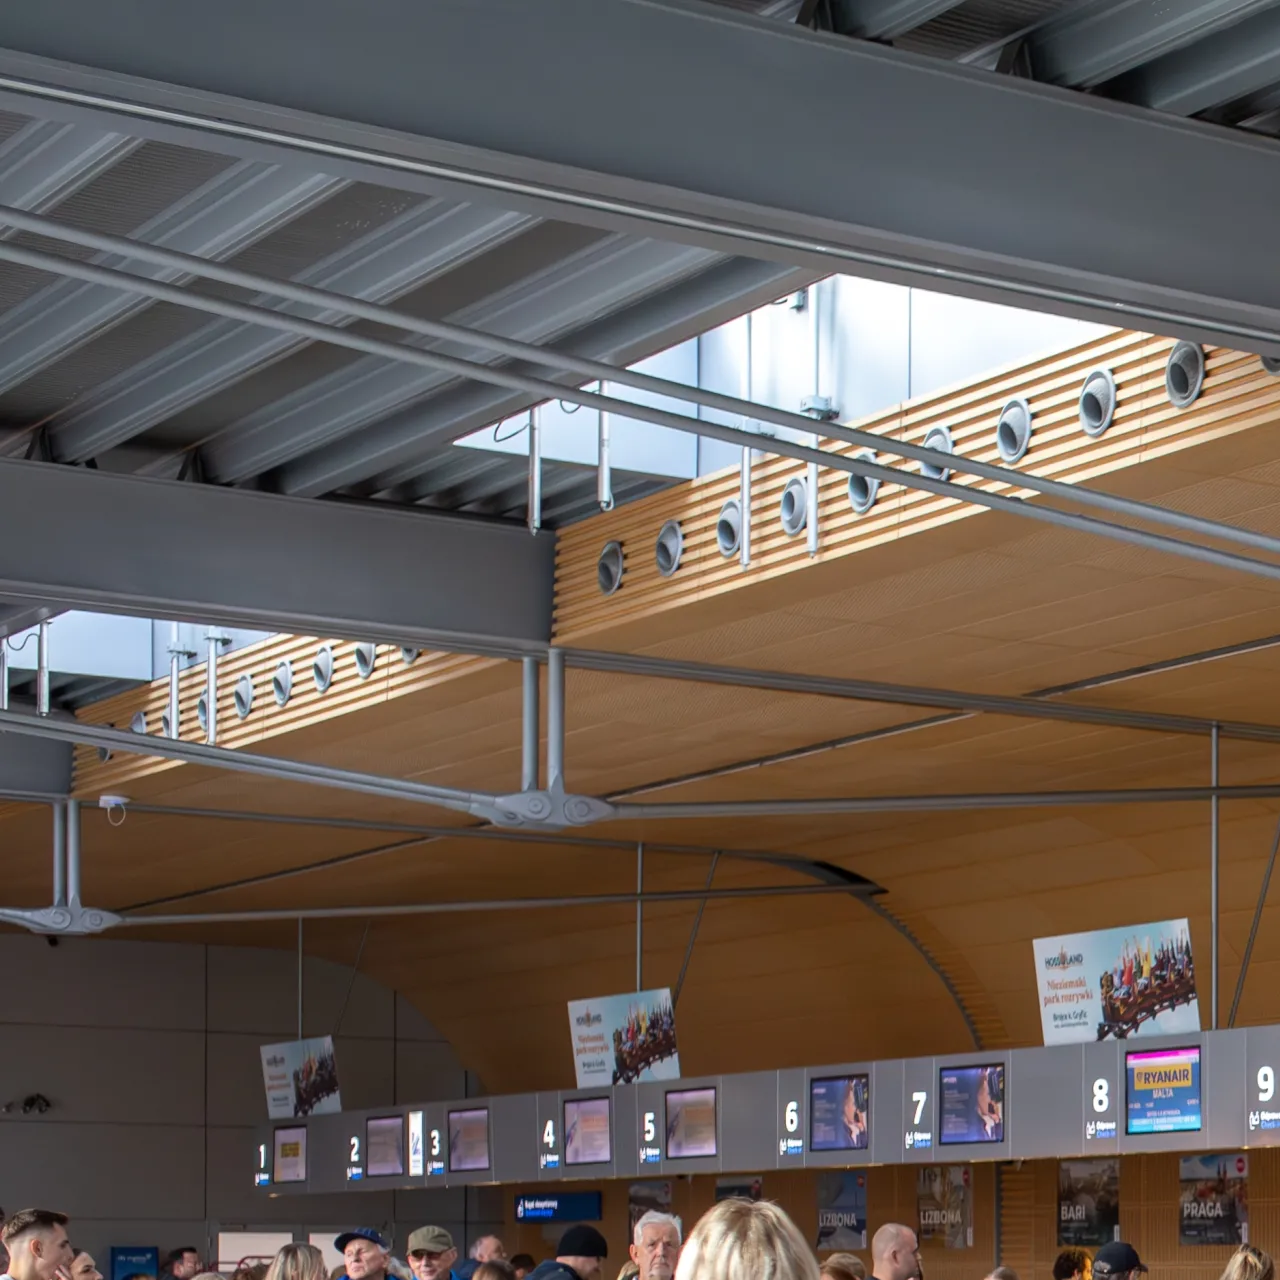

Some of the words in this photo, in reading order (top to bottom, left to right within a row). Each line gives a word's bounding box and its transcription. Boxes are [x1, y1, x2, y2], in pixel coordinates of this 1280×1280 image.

[1144, 1069, 1189, 1084] RYANAIR
[1257, 1066, 1274, 1101] 9
[1093, 1079, 1109, 1112] 8
[1153, 1089, 1173, 1098] MALTA
[785, 1101, 797, 1132] 6
[912, 1092, 926, 1124] 7
[543, 1120, 554, 1148] 4
[644, 1113, 655, 1141] 5
[350, 1137, 359, 1161] 2
[431, 1131, 440, 1155] 3
[259, 1145, 266, 1169] 1
[818, 1212, 856, 1228] LIZBONA
[920, 1208, 962, 1225] LIZBONA
[1060, 1205, 1086, 1220] BARI
[1183, 1202, 1223, 1219] PRAGA
